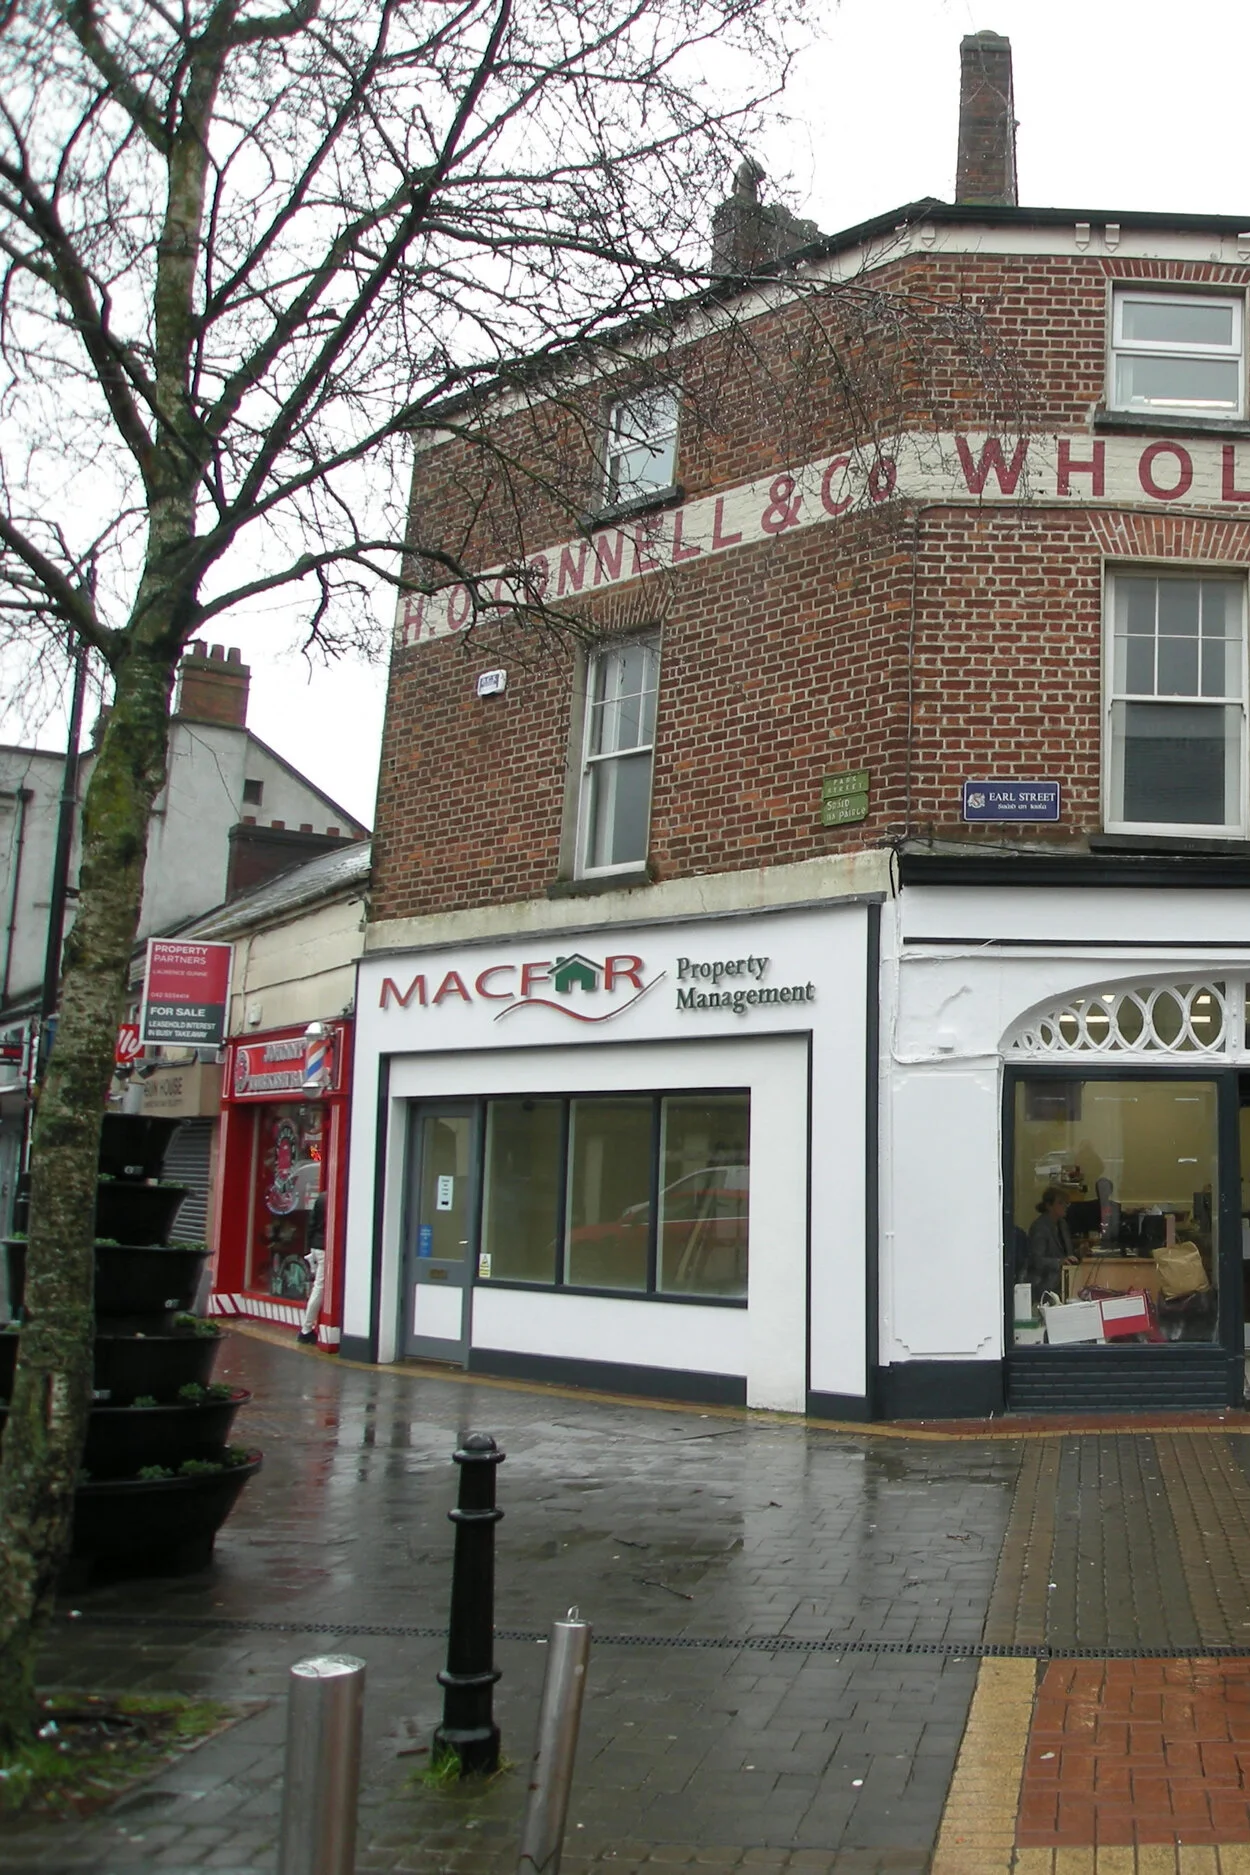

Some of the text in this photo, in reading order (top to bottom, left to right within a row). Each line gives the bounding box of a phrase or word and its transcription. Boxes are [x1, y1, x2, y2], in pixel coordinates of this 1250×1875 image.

[761, 474, 802, 534] &
[989, 792, 1056, 802] EARL STREET
[154, 944, 208, 955] PROPERTY
[153, 954, 207, 965] PARTNERS
[676, 954, 770, 984] Property
[674, 981, 815, 1014] Management
[150, 1006, 206, 1017] FOR SALE
[149, 1020, 216, 1030] LEASEHOLD INTEREST
[155, 1029, 172, 1037] BUSY
[174, 1029, 208, 1038] TAKEAWAY
